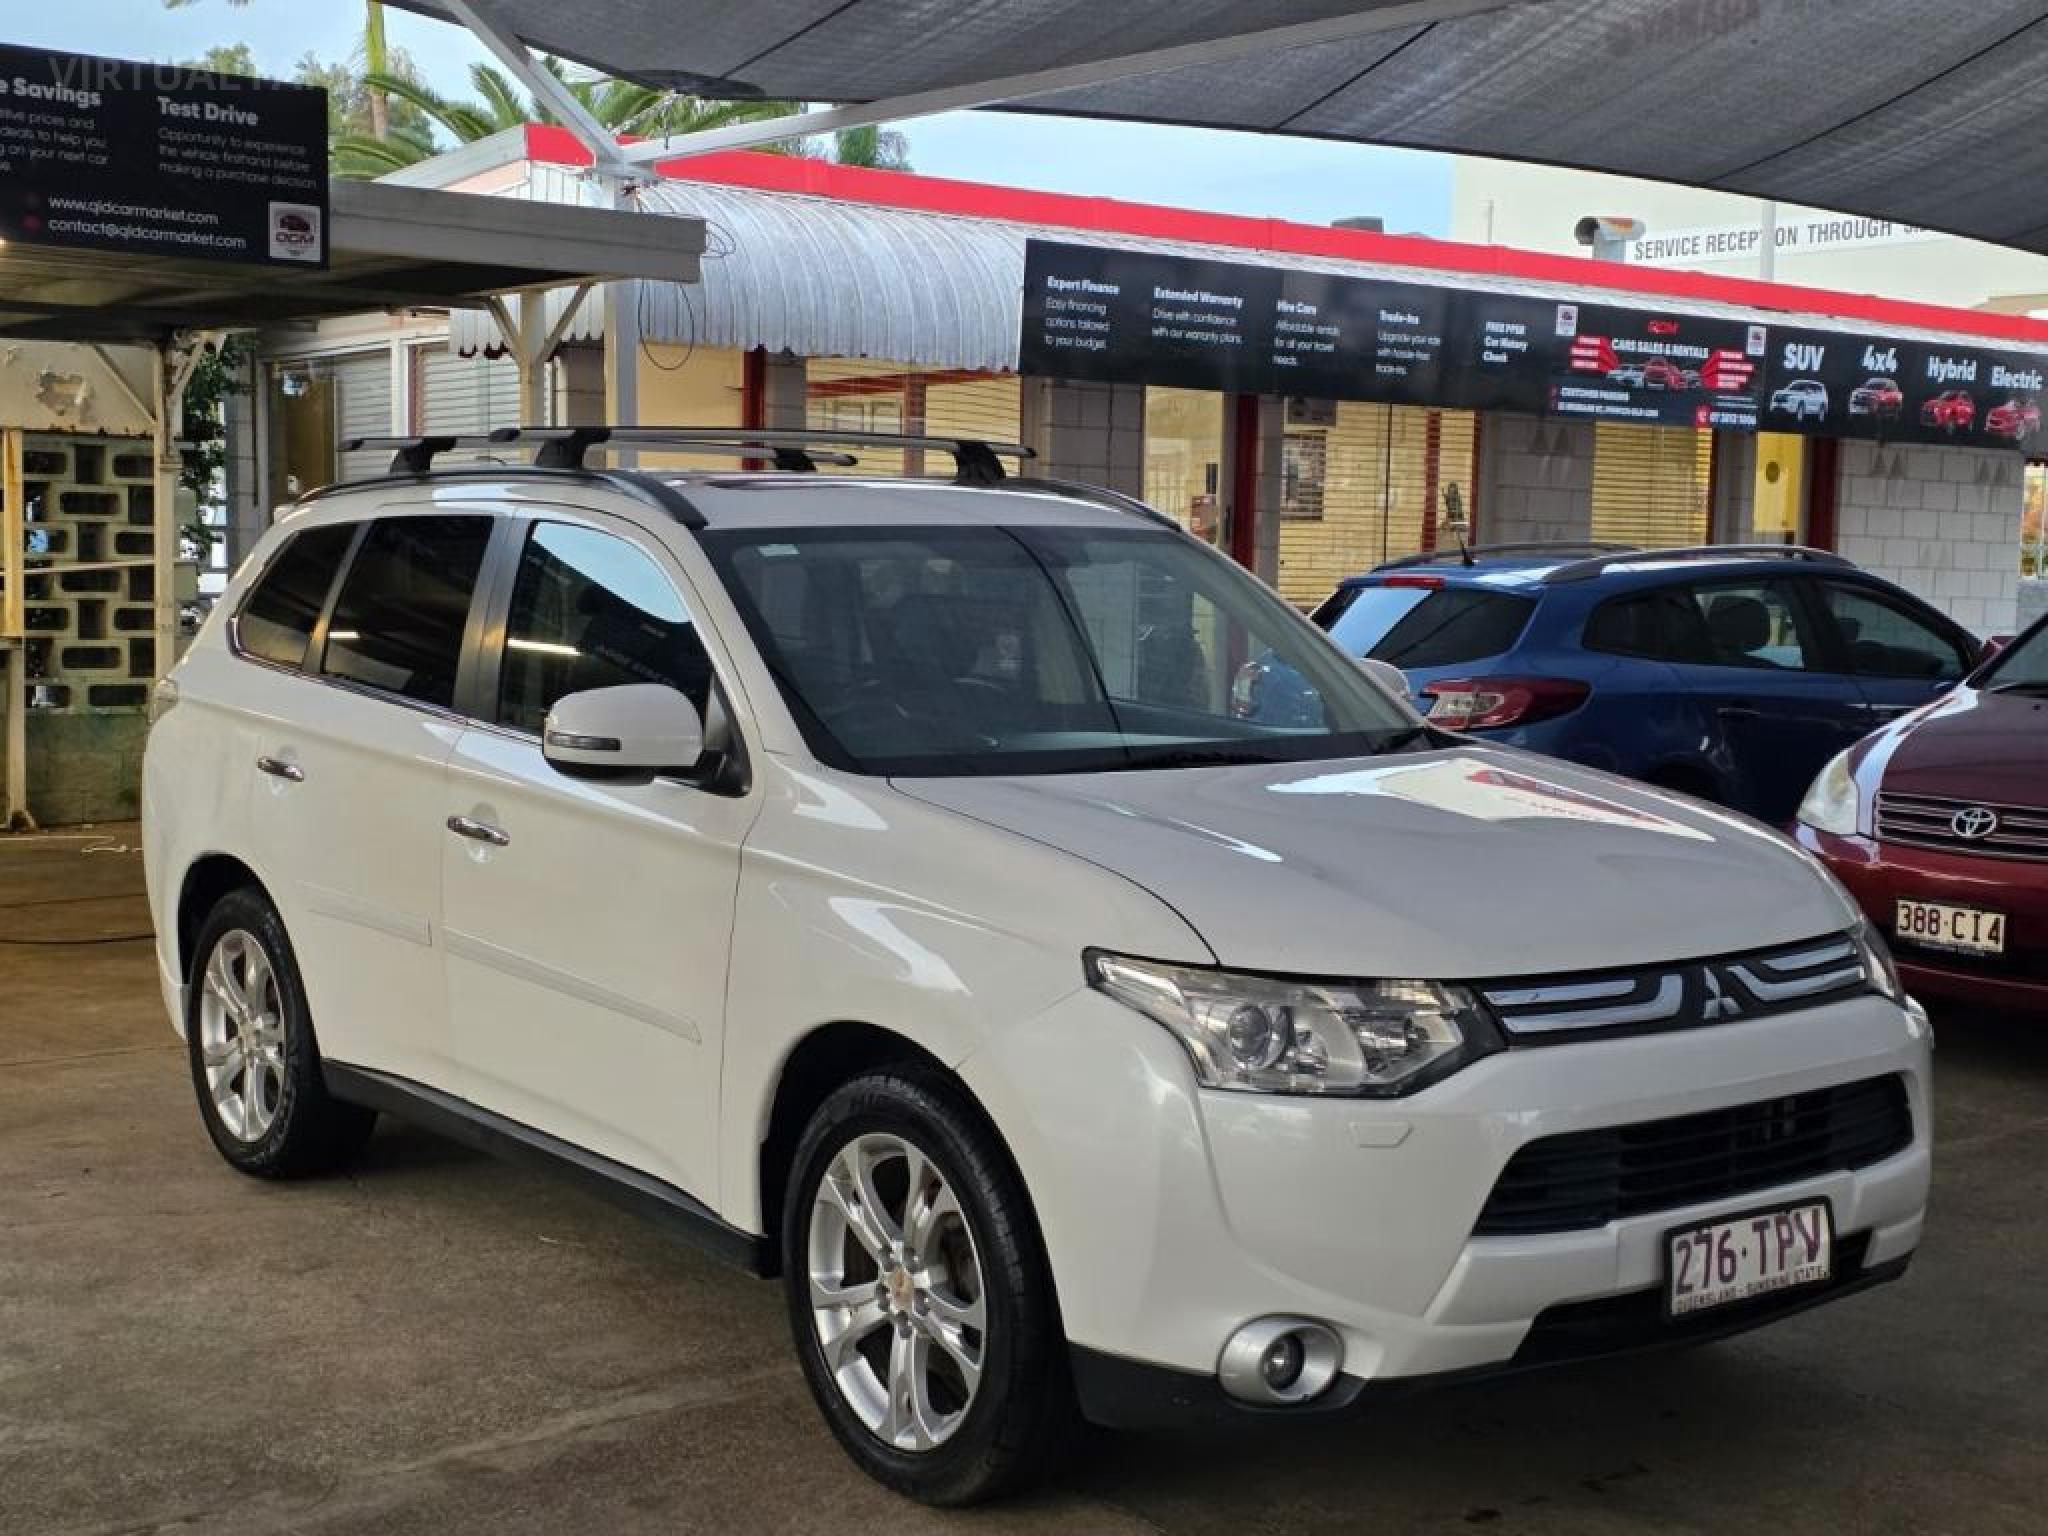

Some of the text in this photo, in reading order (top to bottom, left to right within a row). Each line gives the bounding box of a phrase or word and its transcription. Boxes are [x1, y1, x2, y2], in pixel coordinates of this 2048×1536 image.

[13, 77, 101, 108] Savings
[157, 96, 258, 126] Test Drive
[158, 128, 225, 148] Opportunity
[48, 197, 218, 224] www.qldcarmarket.com
[48, 219, 246, 248] contact@qldcarmarket.com
[1635, 218, 1892, 260] SERVICE RECEPON THROUGH
[1047, 275, 1120, 295] Expert Finance
[1154, 286, 1243, 309] Extended Warranty
[1611, 338, 1635, 351] CARS
[1672, 344, 1708, 359] RENTALS
[1783, 342, 1825, 372] SUV
[1862, 344, 1898, 373] 4x4
[1927, 355, 1977, 382] Hybrid
[1992, 365, 2044, 391] Electric
